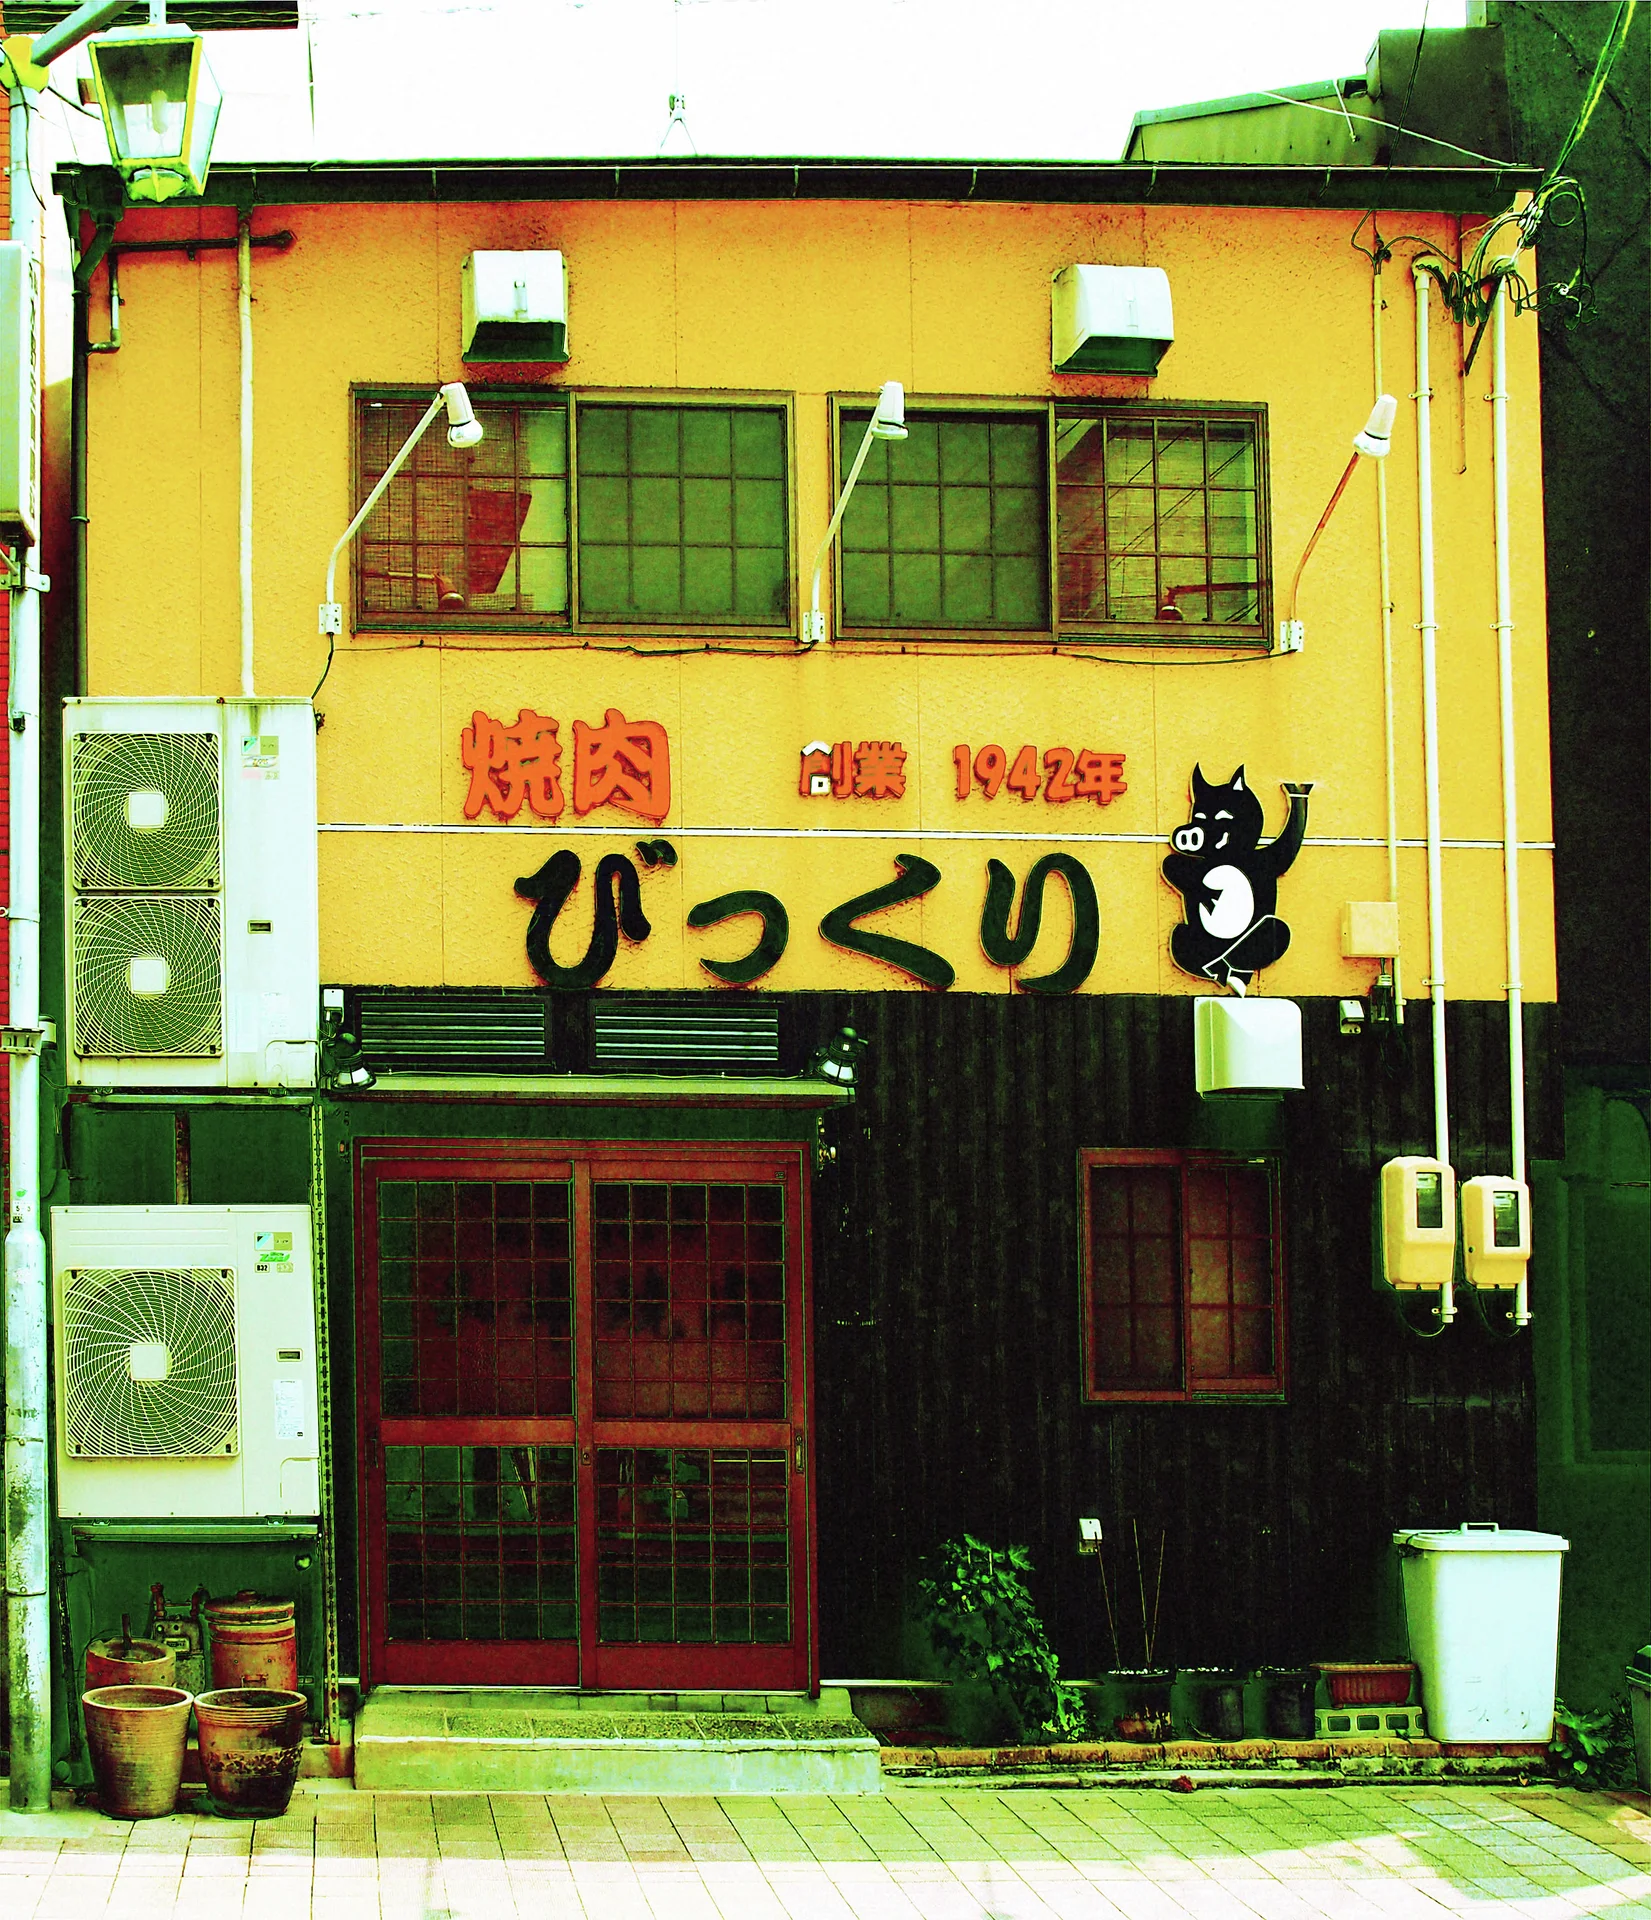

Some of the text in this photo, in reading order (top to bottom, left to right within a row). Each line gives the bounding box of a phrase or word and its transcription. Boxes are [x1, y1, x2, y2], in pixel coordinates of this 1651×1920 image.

[463, 709, 671, 821] 焼肉
[799, 740, 1127, 807] 創業 1942年
[514, 840, 1100, 993] びっくり
